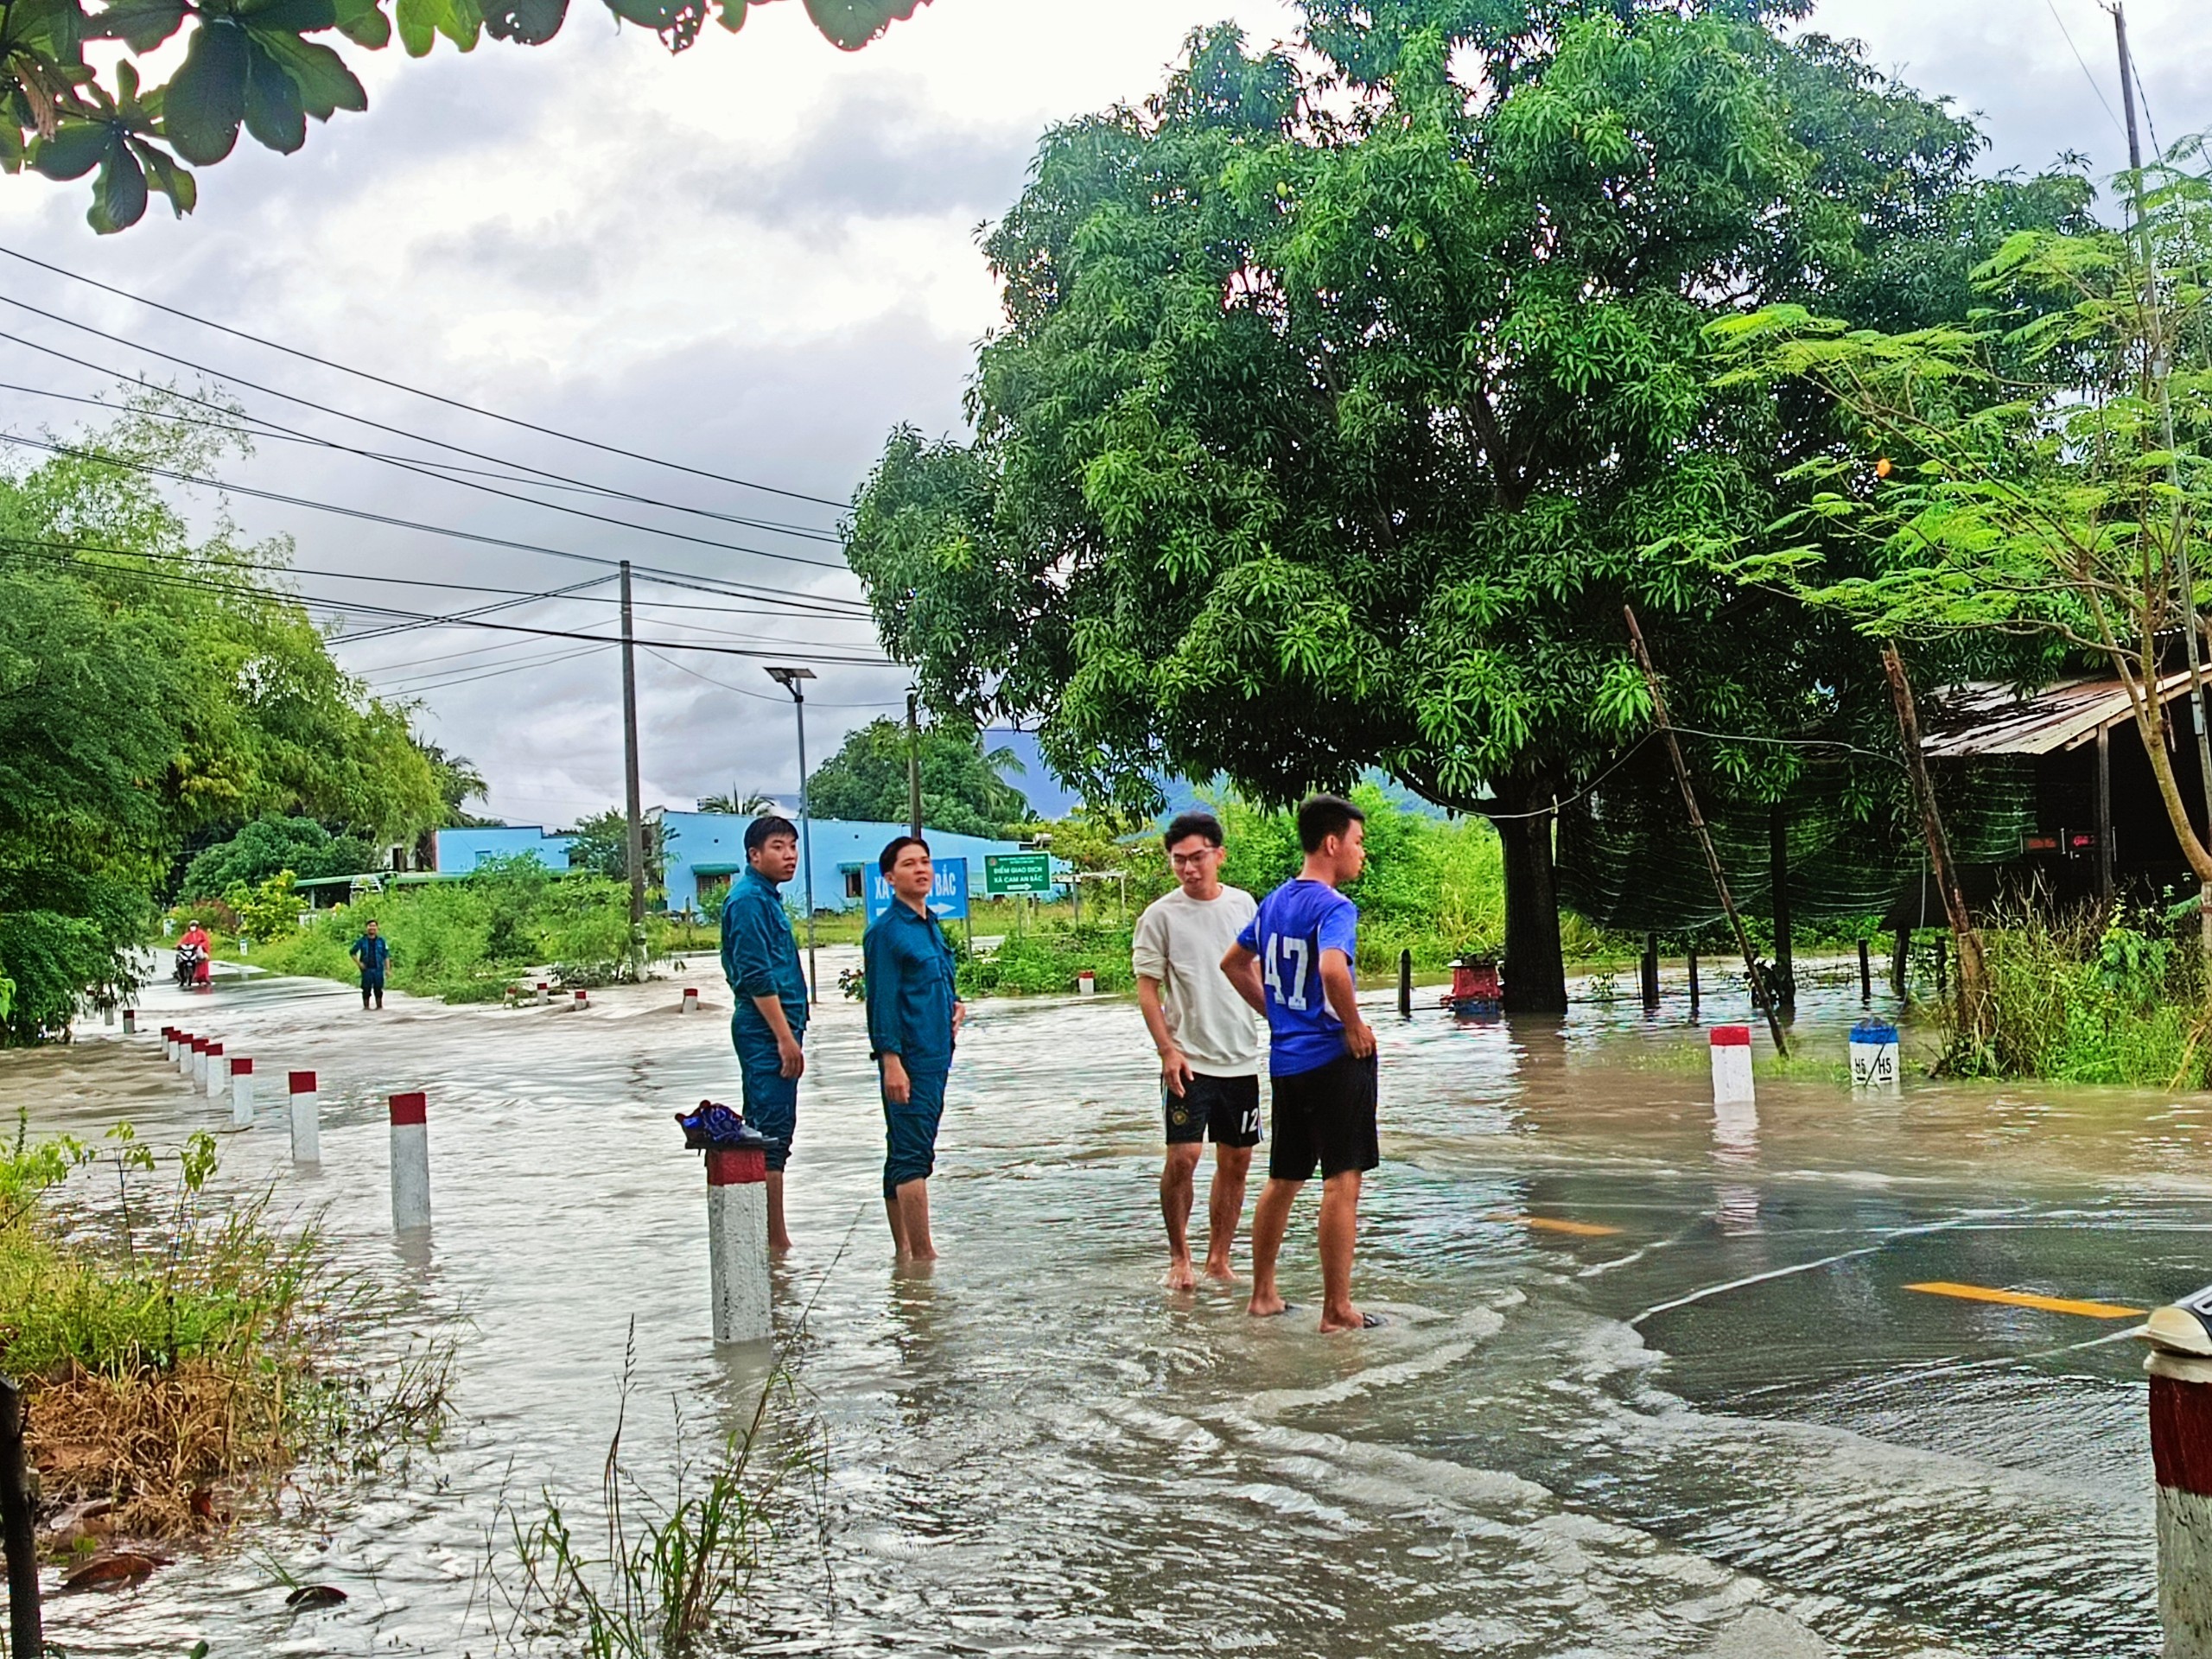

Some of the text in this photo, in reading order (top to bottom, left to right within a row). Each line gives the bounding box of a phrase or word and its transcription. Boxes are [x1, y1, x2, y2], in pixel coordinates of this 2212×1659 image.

[1264, 932, 1309, 1011] 47
[1878, 1057, 1892, 1075] H5
[1241, 1108, 1259, 1134] 12
